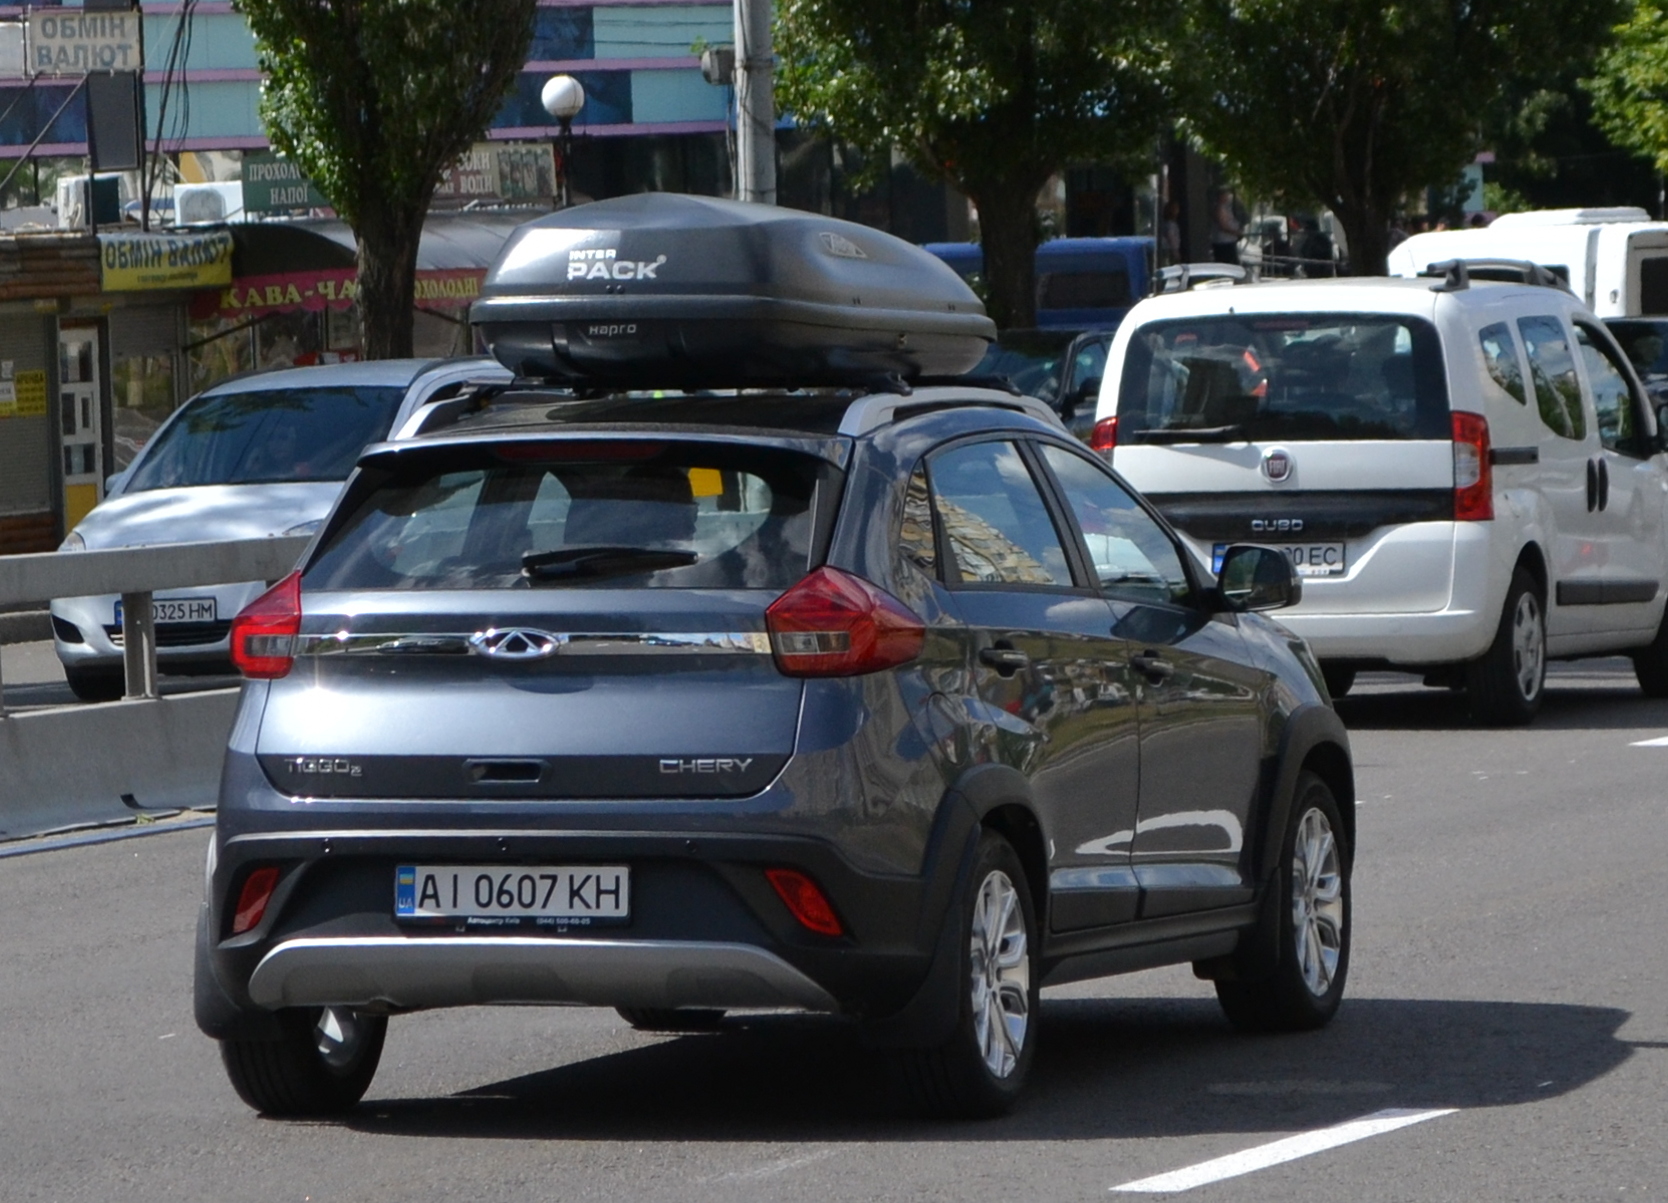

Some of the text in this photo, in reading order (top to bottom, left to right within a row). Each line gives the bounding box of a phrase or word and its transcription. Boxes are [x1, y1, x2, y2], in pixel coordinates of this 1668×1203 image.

[41, 15, 125, 38] ОБМІН
[37, 44, 131, 67] ВАЛЮТ
[105, 235, 229, 269] ОБМІН ВАЛЮТ
[569, 249, 616, 260] INTER
[567, 255, 667, 280] PACK
[220, 278, 358, 309] КАВА-ЧА
[1309, 546, 1337, 567] EC
[188, 602, 213, 619] HM
[659, 757, 753, 774] CHERY
[418, 873, 621, 910] AI 0607 KH
